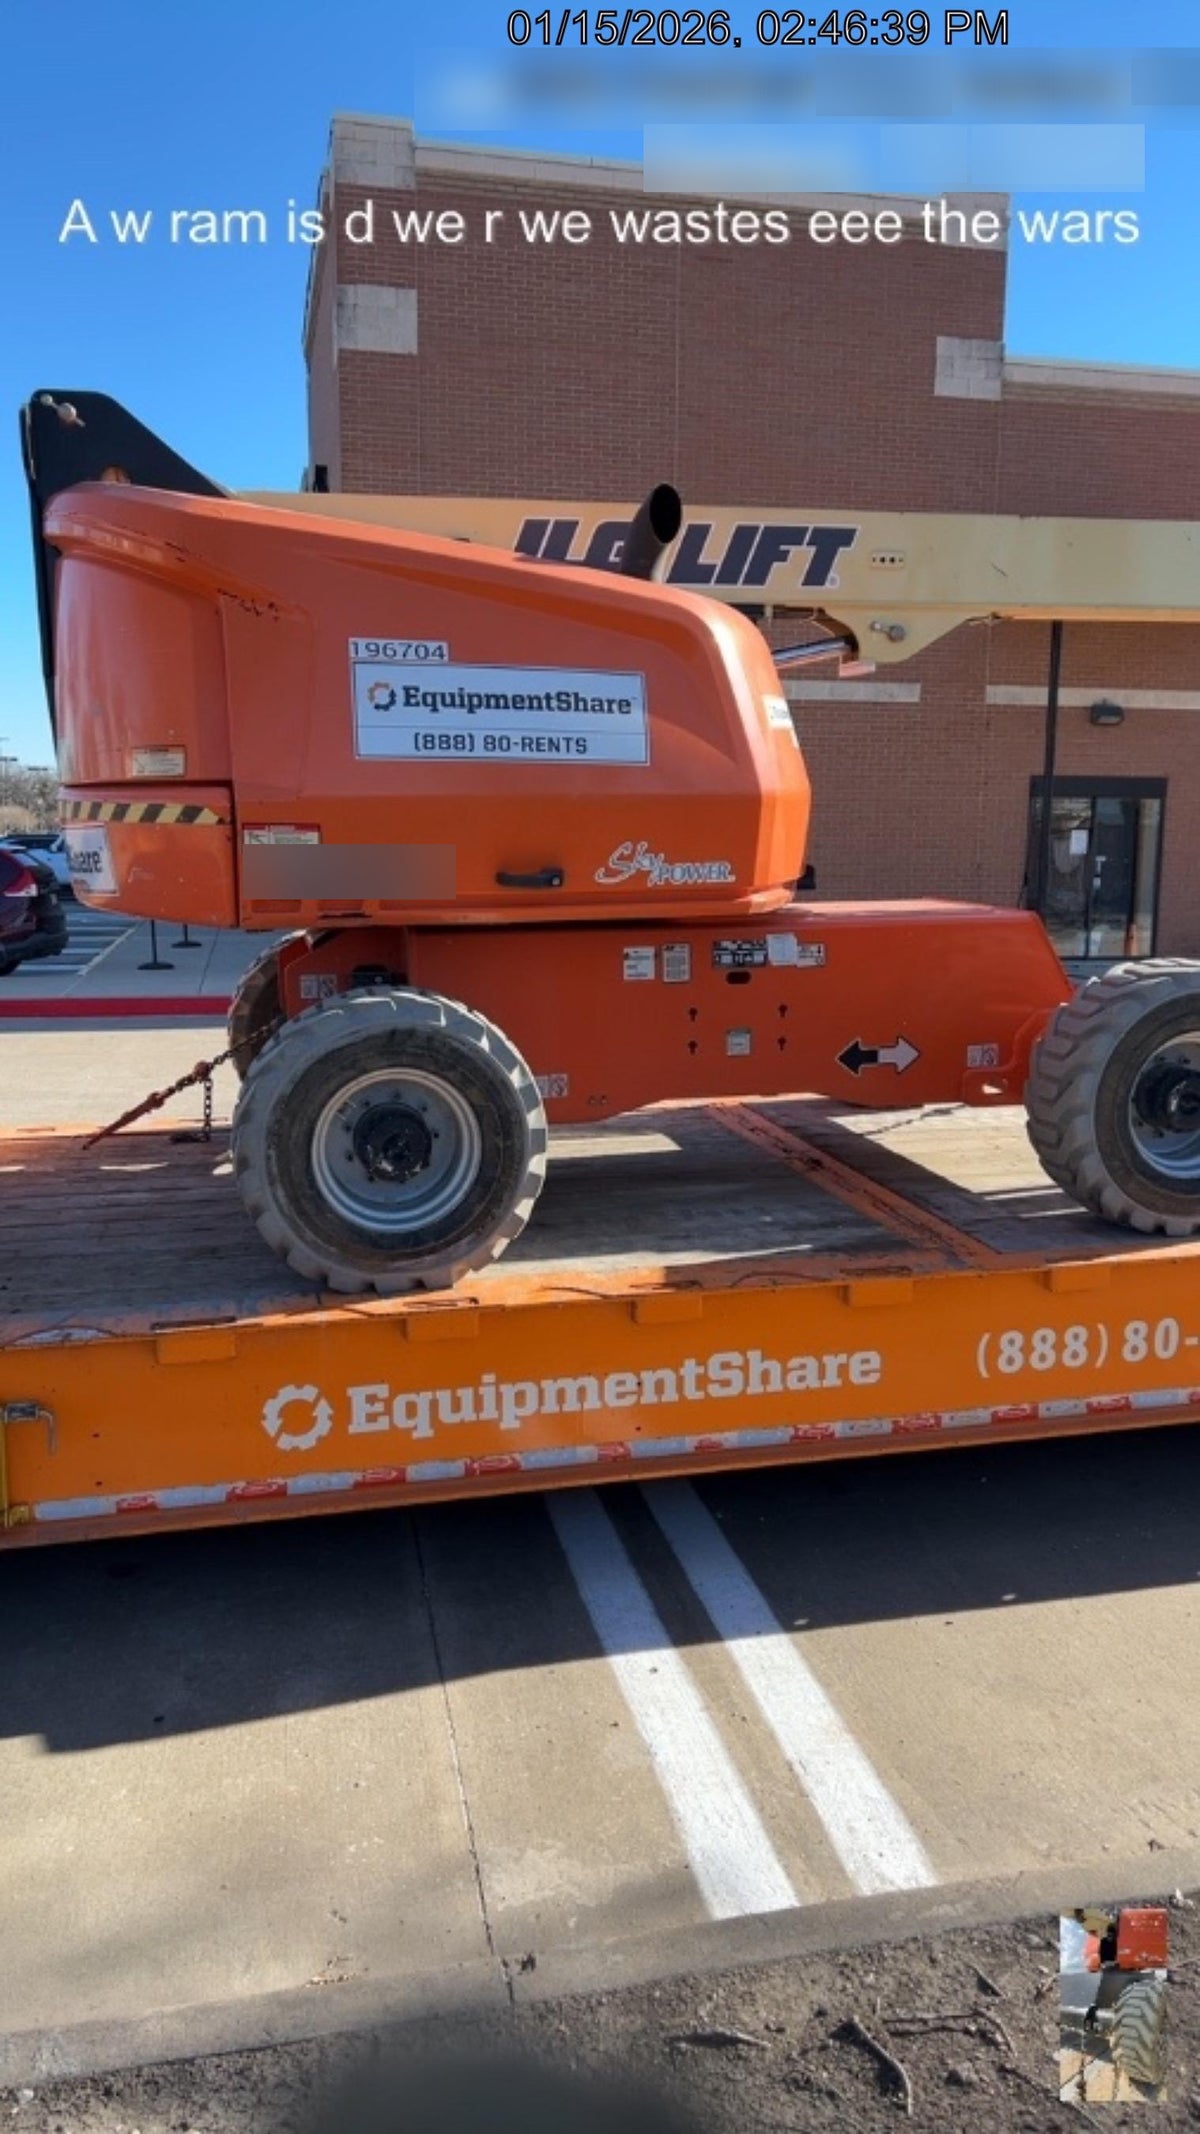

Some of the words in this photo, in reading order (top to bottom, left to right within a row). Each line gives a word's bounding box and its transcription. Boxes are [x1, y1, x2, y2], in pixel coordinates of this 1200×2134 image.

[664, 522, 860, 588] LIFT
[351, 641, 446, 660] 196704
[401, 685, 633, 715] EquipmentShare
[413, 732, 476, 752] (888)
[483, 734, 588, 754] 80-RENTS
[976, 1322, 1109, 1379] (888)
[1121, 1317, 1200, 1363] 80-
[346, 1349, 882, 1440] EquipmentShare
